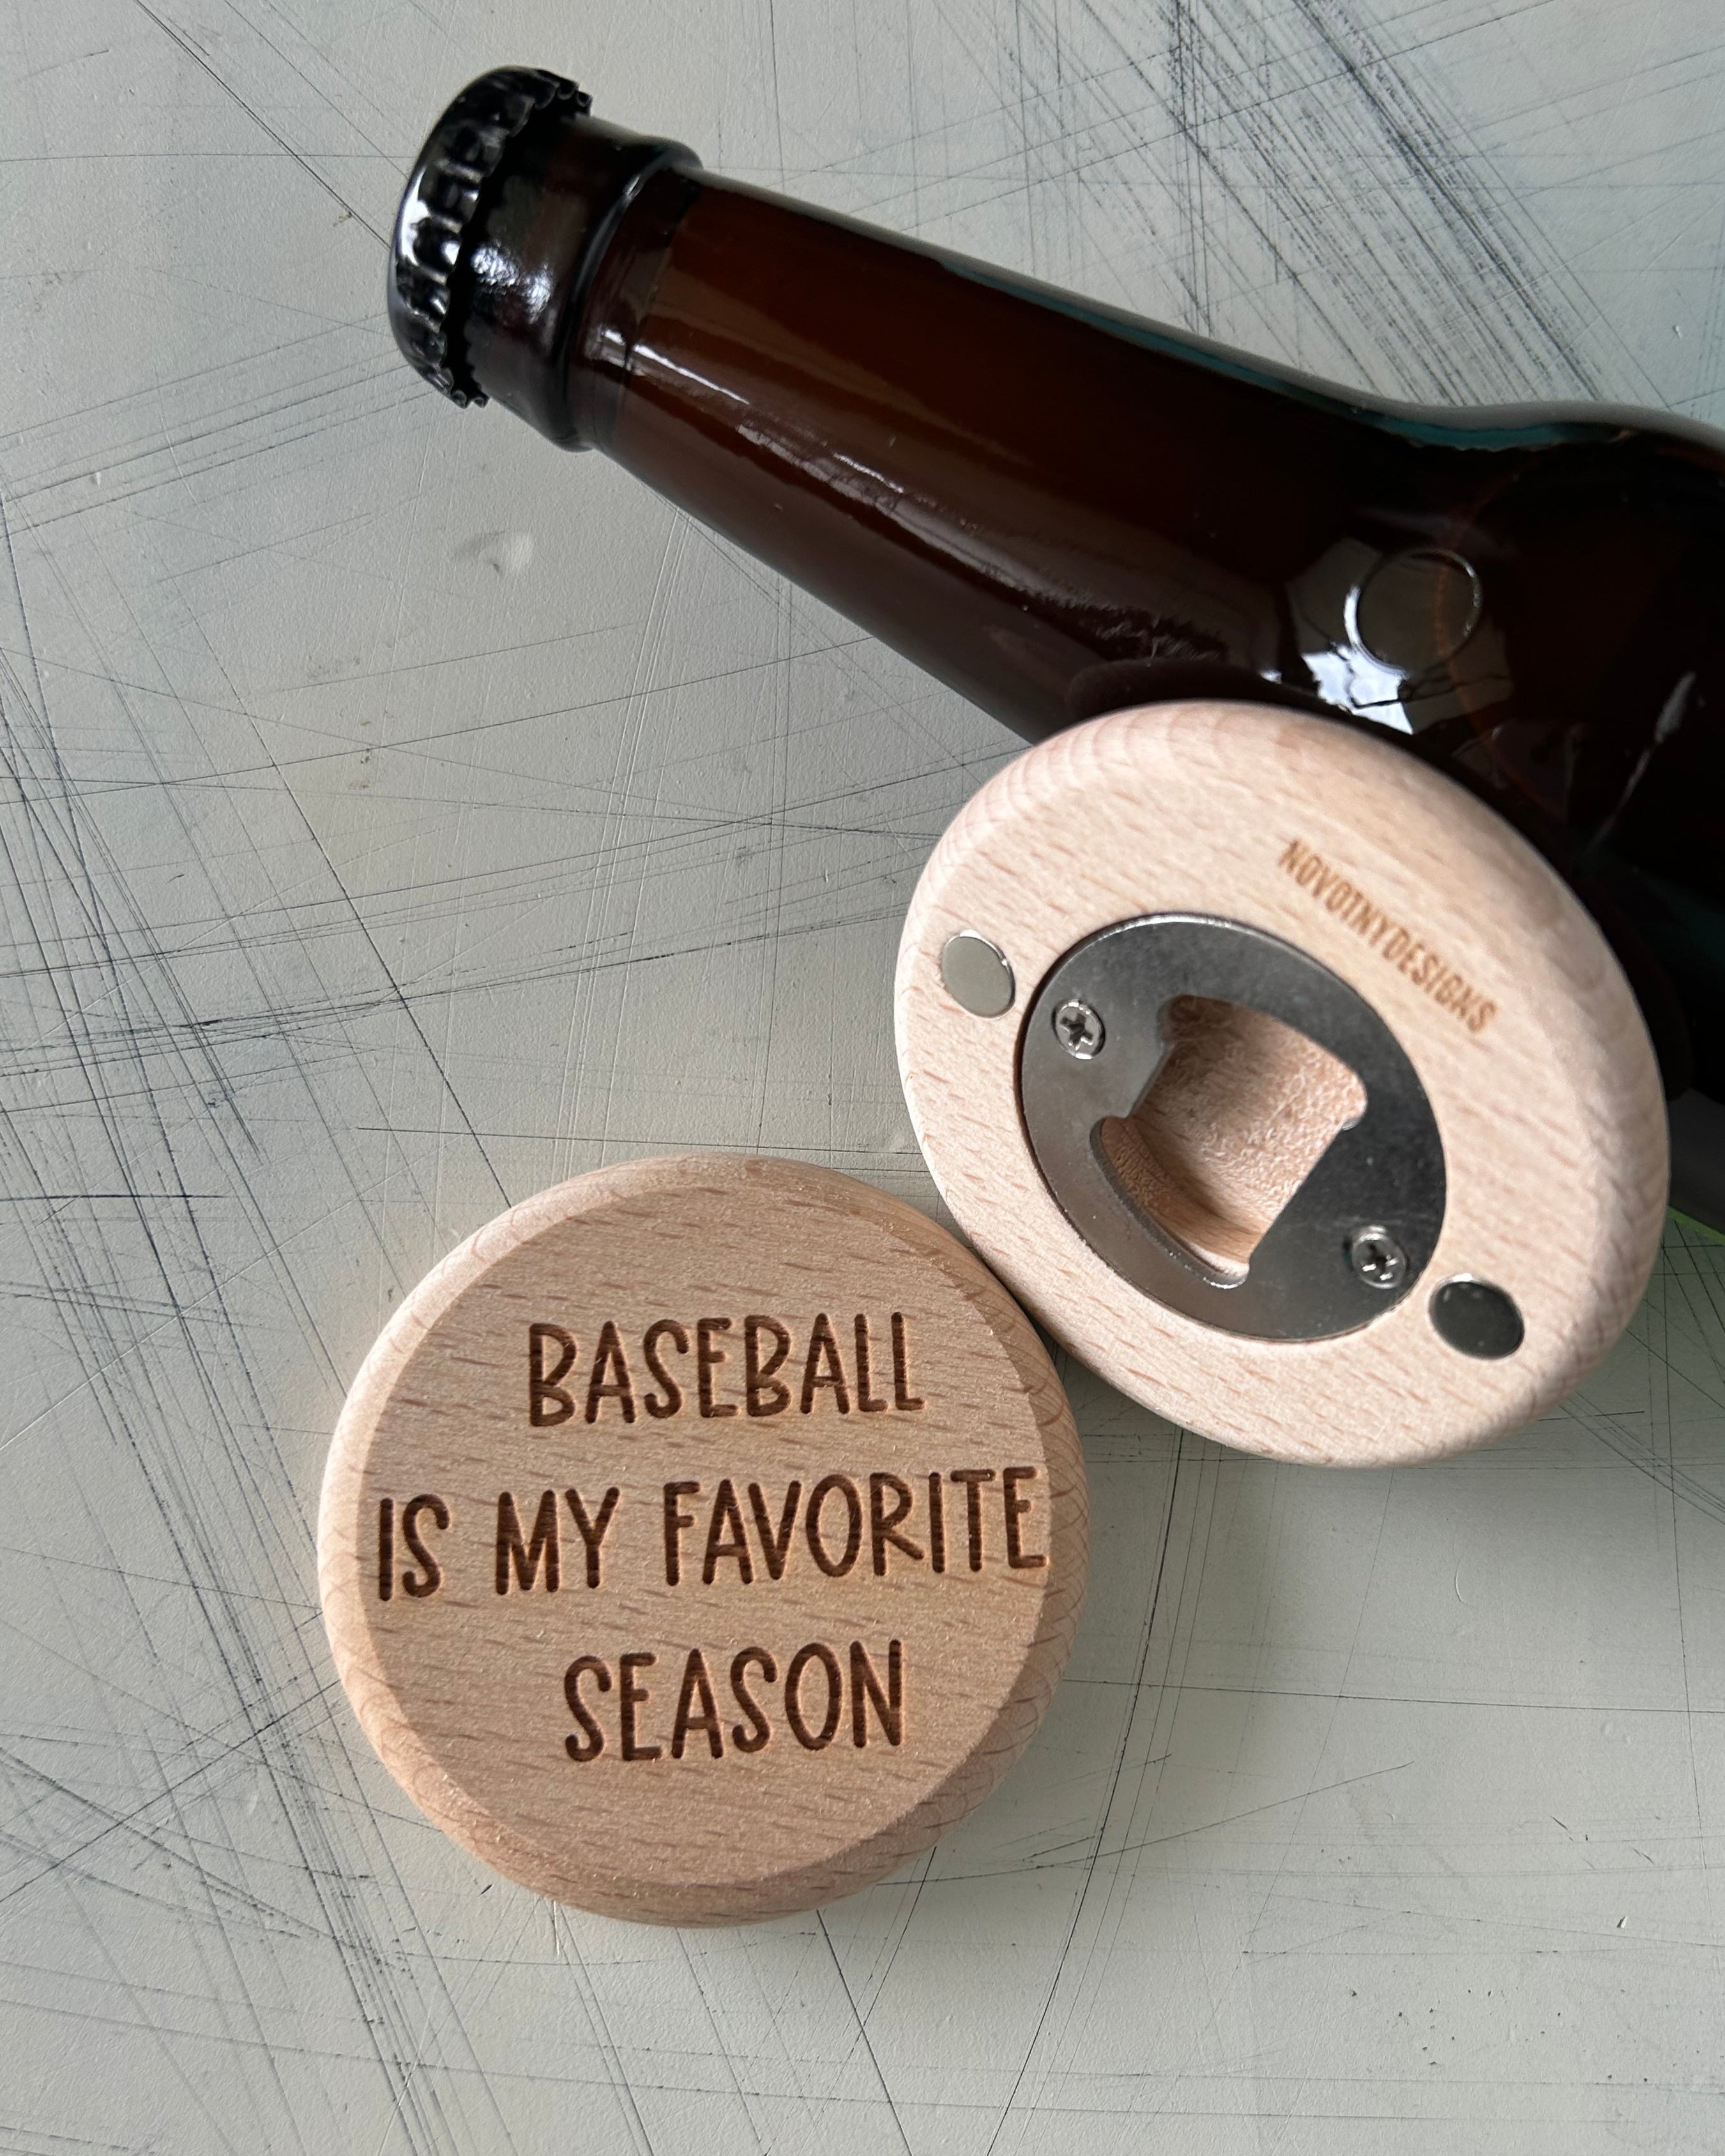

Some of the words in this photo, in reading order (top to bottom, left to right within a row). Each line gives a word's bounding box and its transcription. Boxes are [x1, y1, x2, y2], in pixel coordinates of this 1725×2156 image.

[1278, 839, 1497, 1032] NOVOTNYDESIGNS
[528, 1312, 925, 1427] BASEBALL
[378, 1493, 450, 1602] IS
[496, 1487, 620, 1595] MY
[664, 1466, 1049, 1586] FAVORITE
[563, 1639, 903, 1763] SEASON
